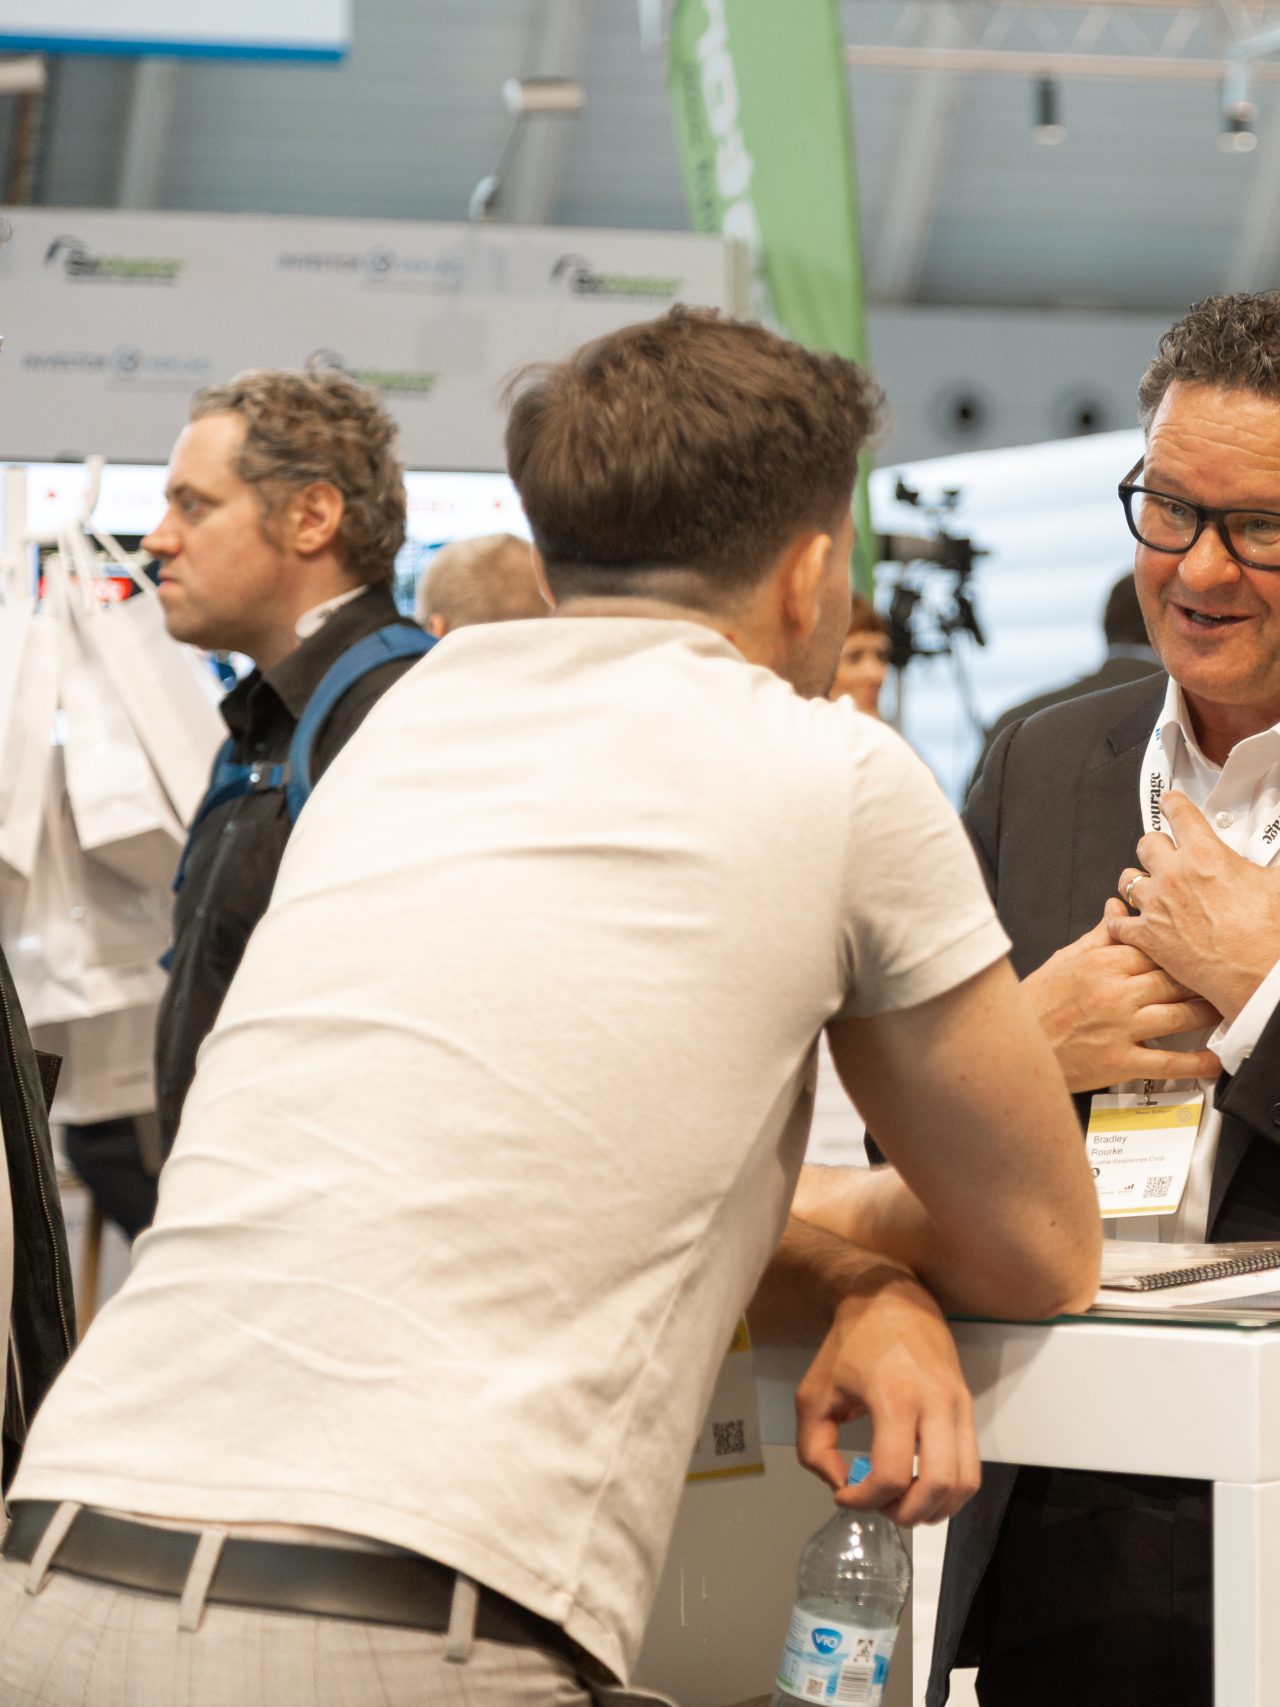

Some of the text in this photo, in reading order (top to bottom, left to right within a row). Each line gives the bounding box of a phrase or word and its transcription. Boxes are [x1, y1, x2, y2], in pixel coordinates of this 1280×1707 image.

[1150, 771, 1165, 832] courage
[1093, 1135, 1127, 1144] Bradley
[1092, 1148, 1123, 1156] Rourke
